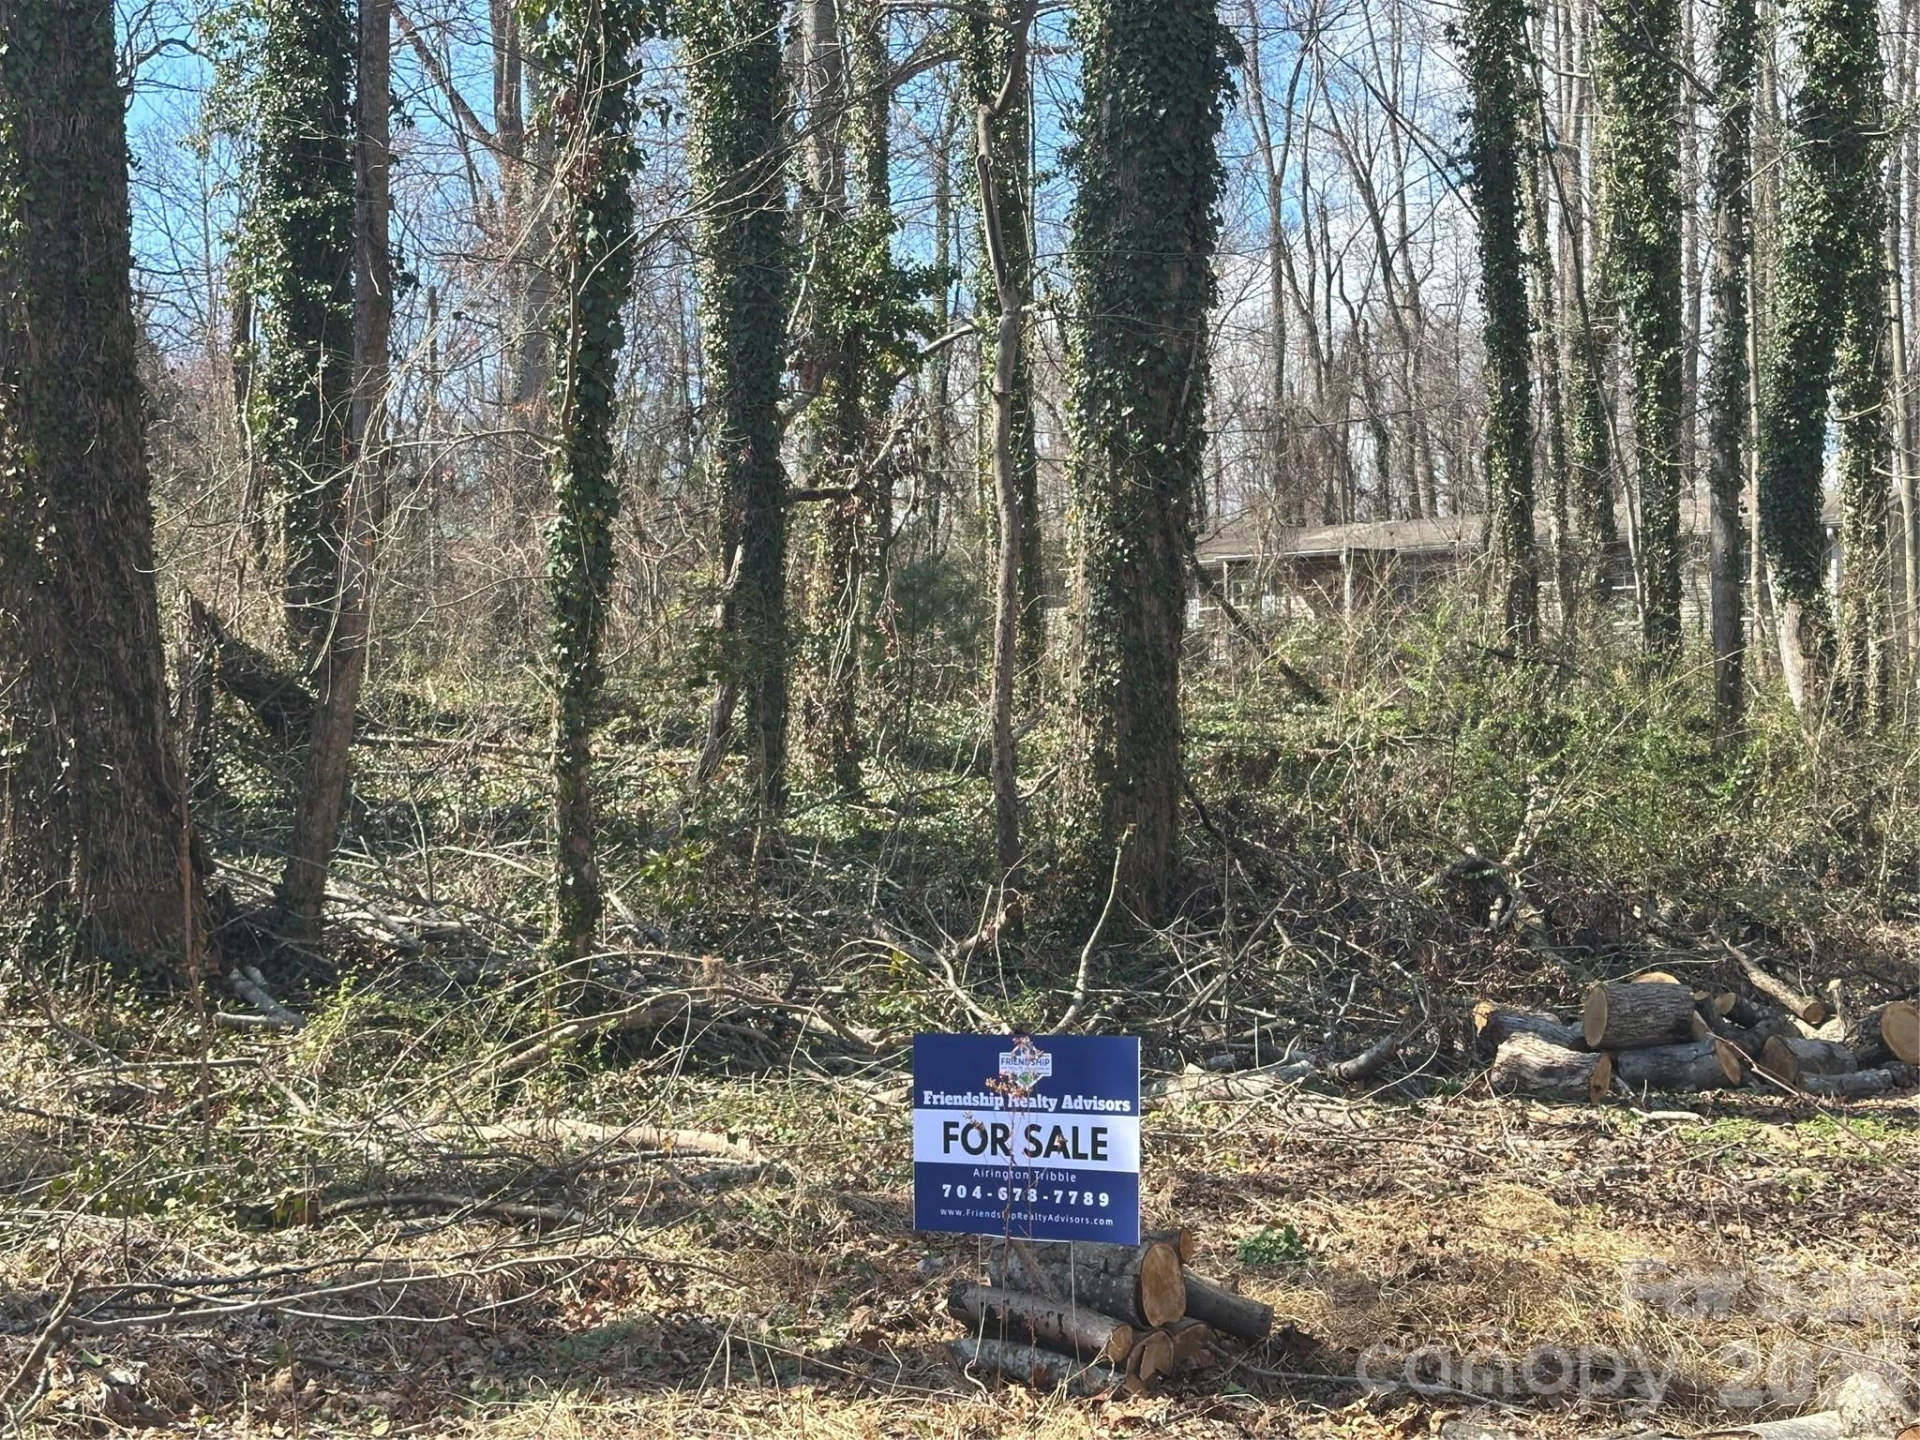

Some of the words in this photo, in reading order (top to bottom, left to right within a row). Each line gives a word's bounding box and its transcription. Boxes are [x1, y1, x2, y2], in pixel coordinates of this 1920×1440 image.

[923, 1091, 1004, 1110] Friendship
[1008, 1093, 1058, 1112] Realty
[1062, 1094, 1131, 1112] Advisors
[943, 1121, 1012, 1157] FOR
[1023, 1123, 1108, 1161] SALE
[973, 1168, 1029, 1181] Airington
[1034, 1170, 1077, 1183] Tribble
[942, 1184, 1110, 1207] 704-678-7789
